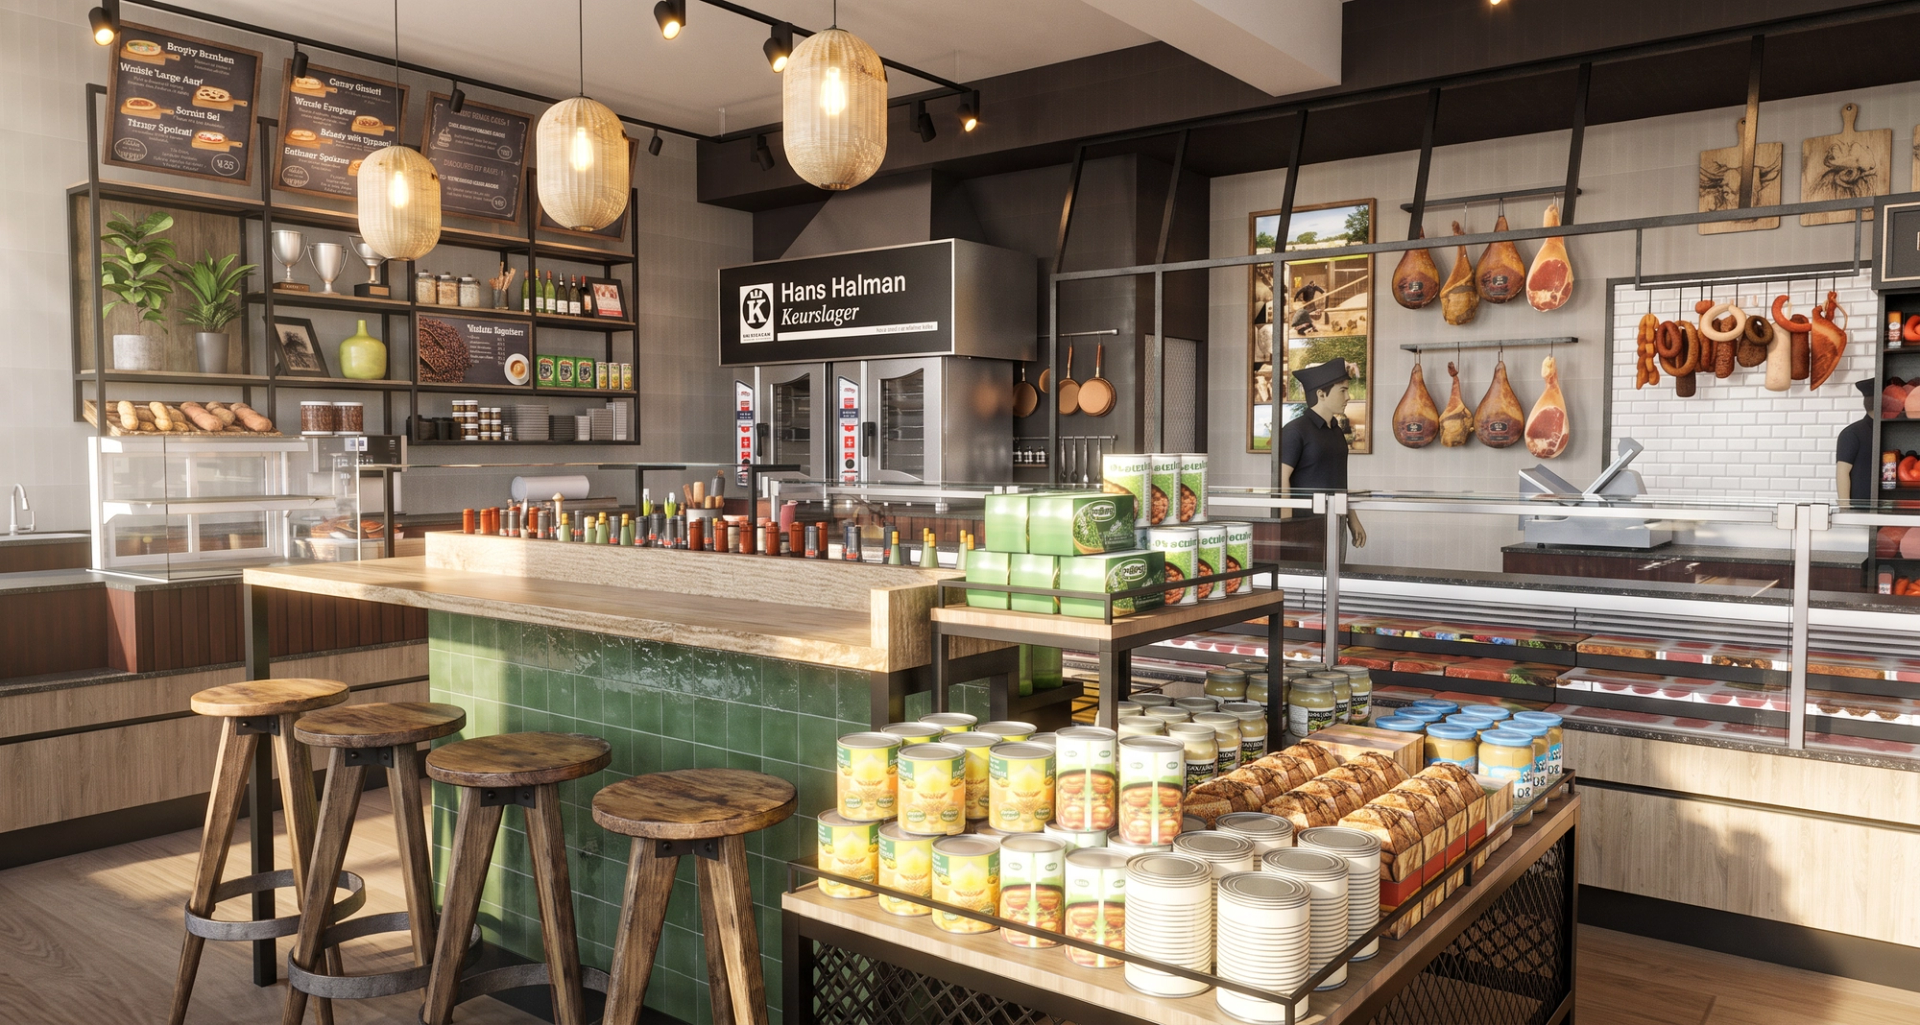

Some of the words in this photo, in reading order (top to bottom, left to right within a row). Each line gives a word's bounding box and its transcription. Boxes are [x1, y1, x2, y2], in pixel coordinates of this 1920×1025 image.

[781, 282, 826, 303] Hans
[832, 274, 906, 298] Halman
[747, 298, 767, 324] K
[781, 304, 860, 327] Keurslager
